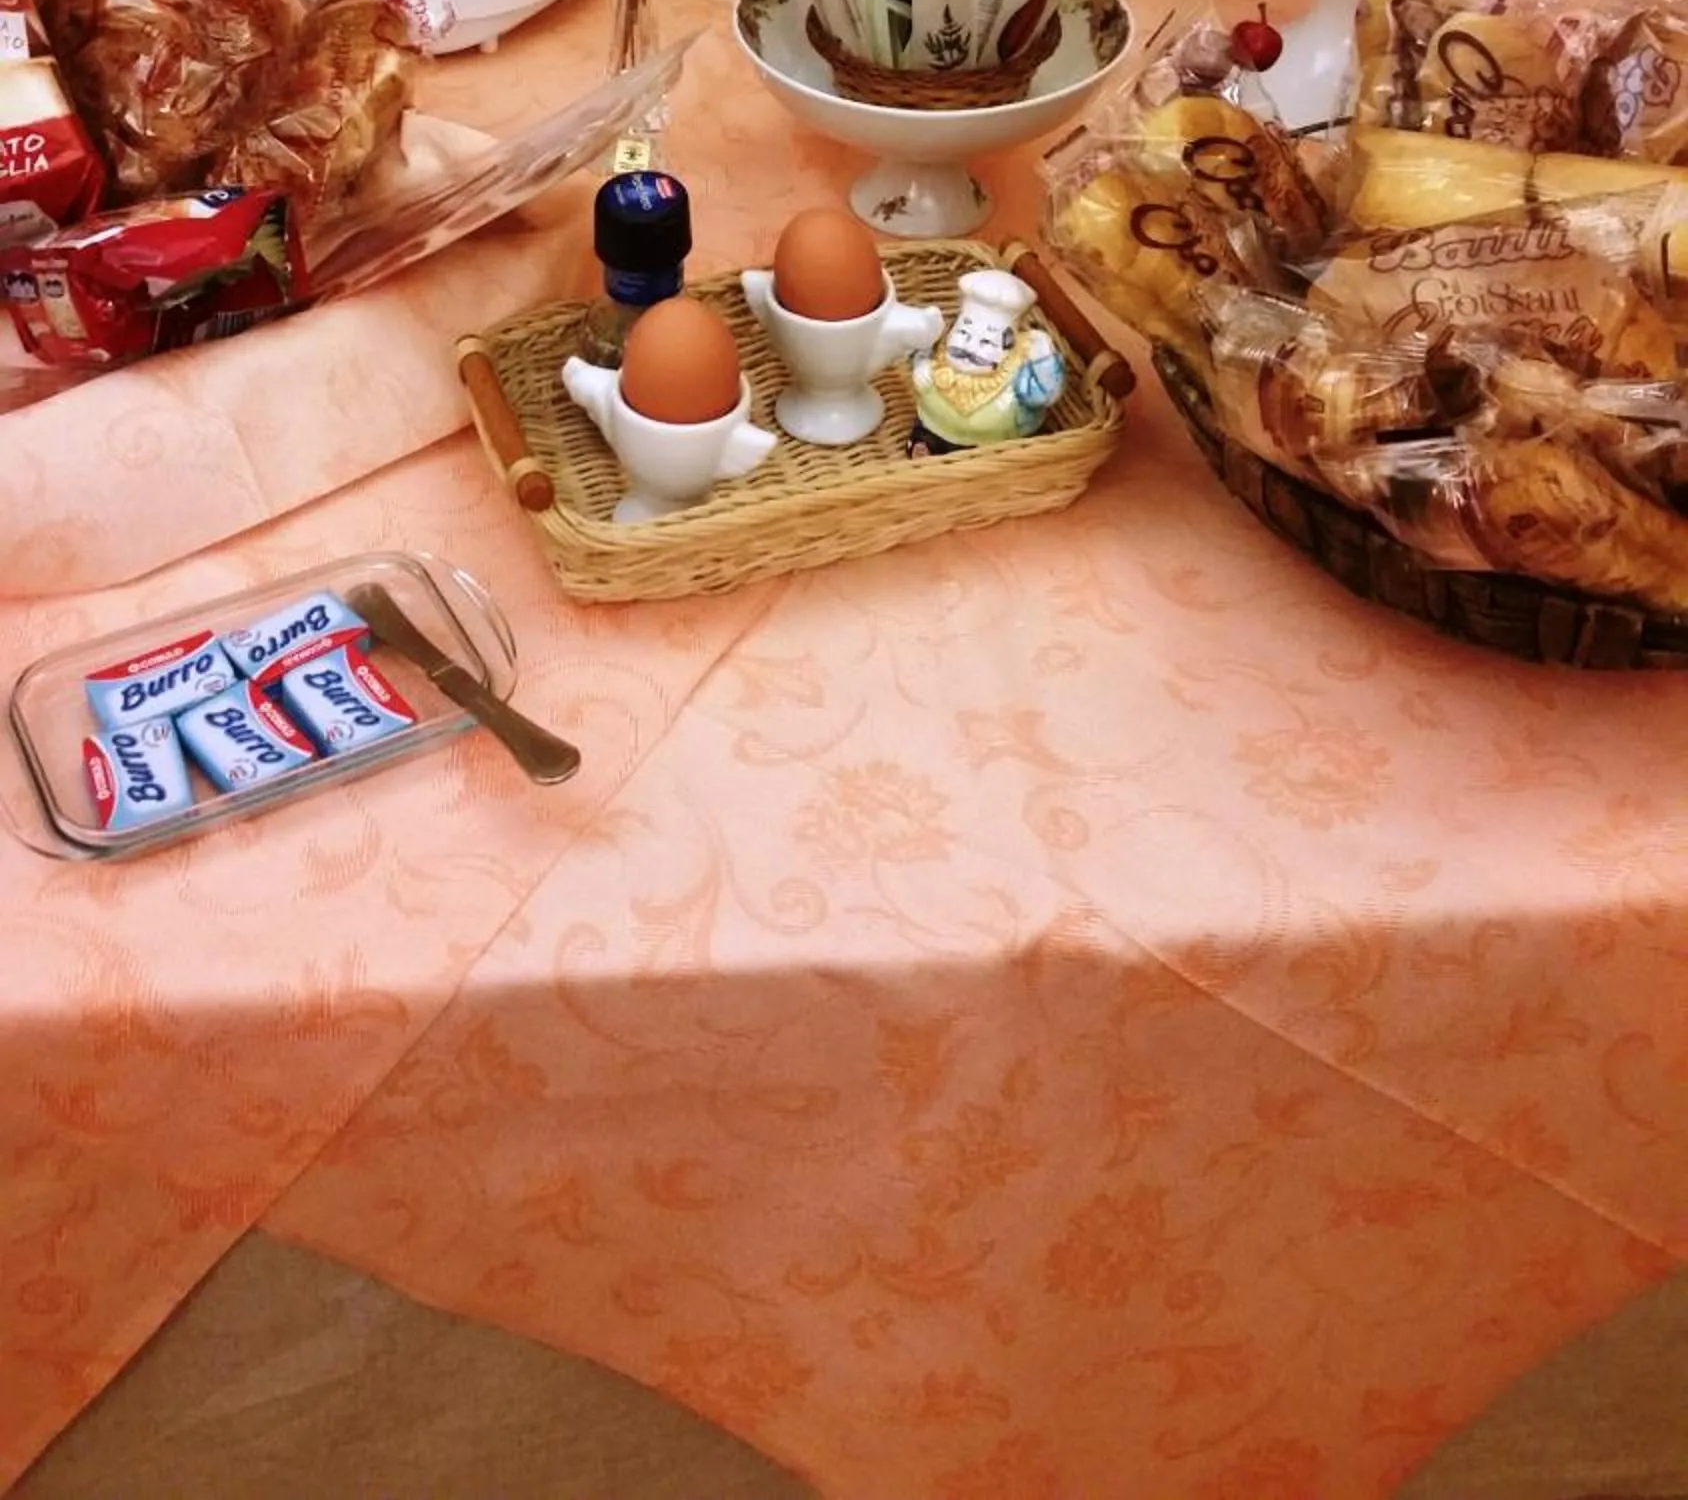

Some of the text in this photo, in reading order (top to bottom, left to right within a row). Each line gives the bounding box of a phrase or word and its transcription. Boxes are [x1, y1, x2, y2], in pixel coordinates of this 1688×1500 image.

[249, 604, 332, 663] Burro
[120, 652, 215, 712] Burro
[303, 668, 381, 727] Burro
[204, 707, 286, 765] Burro
[111, 733, 167, 804] Burro
